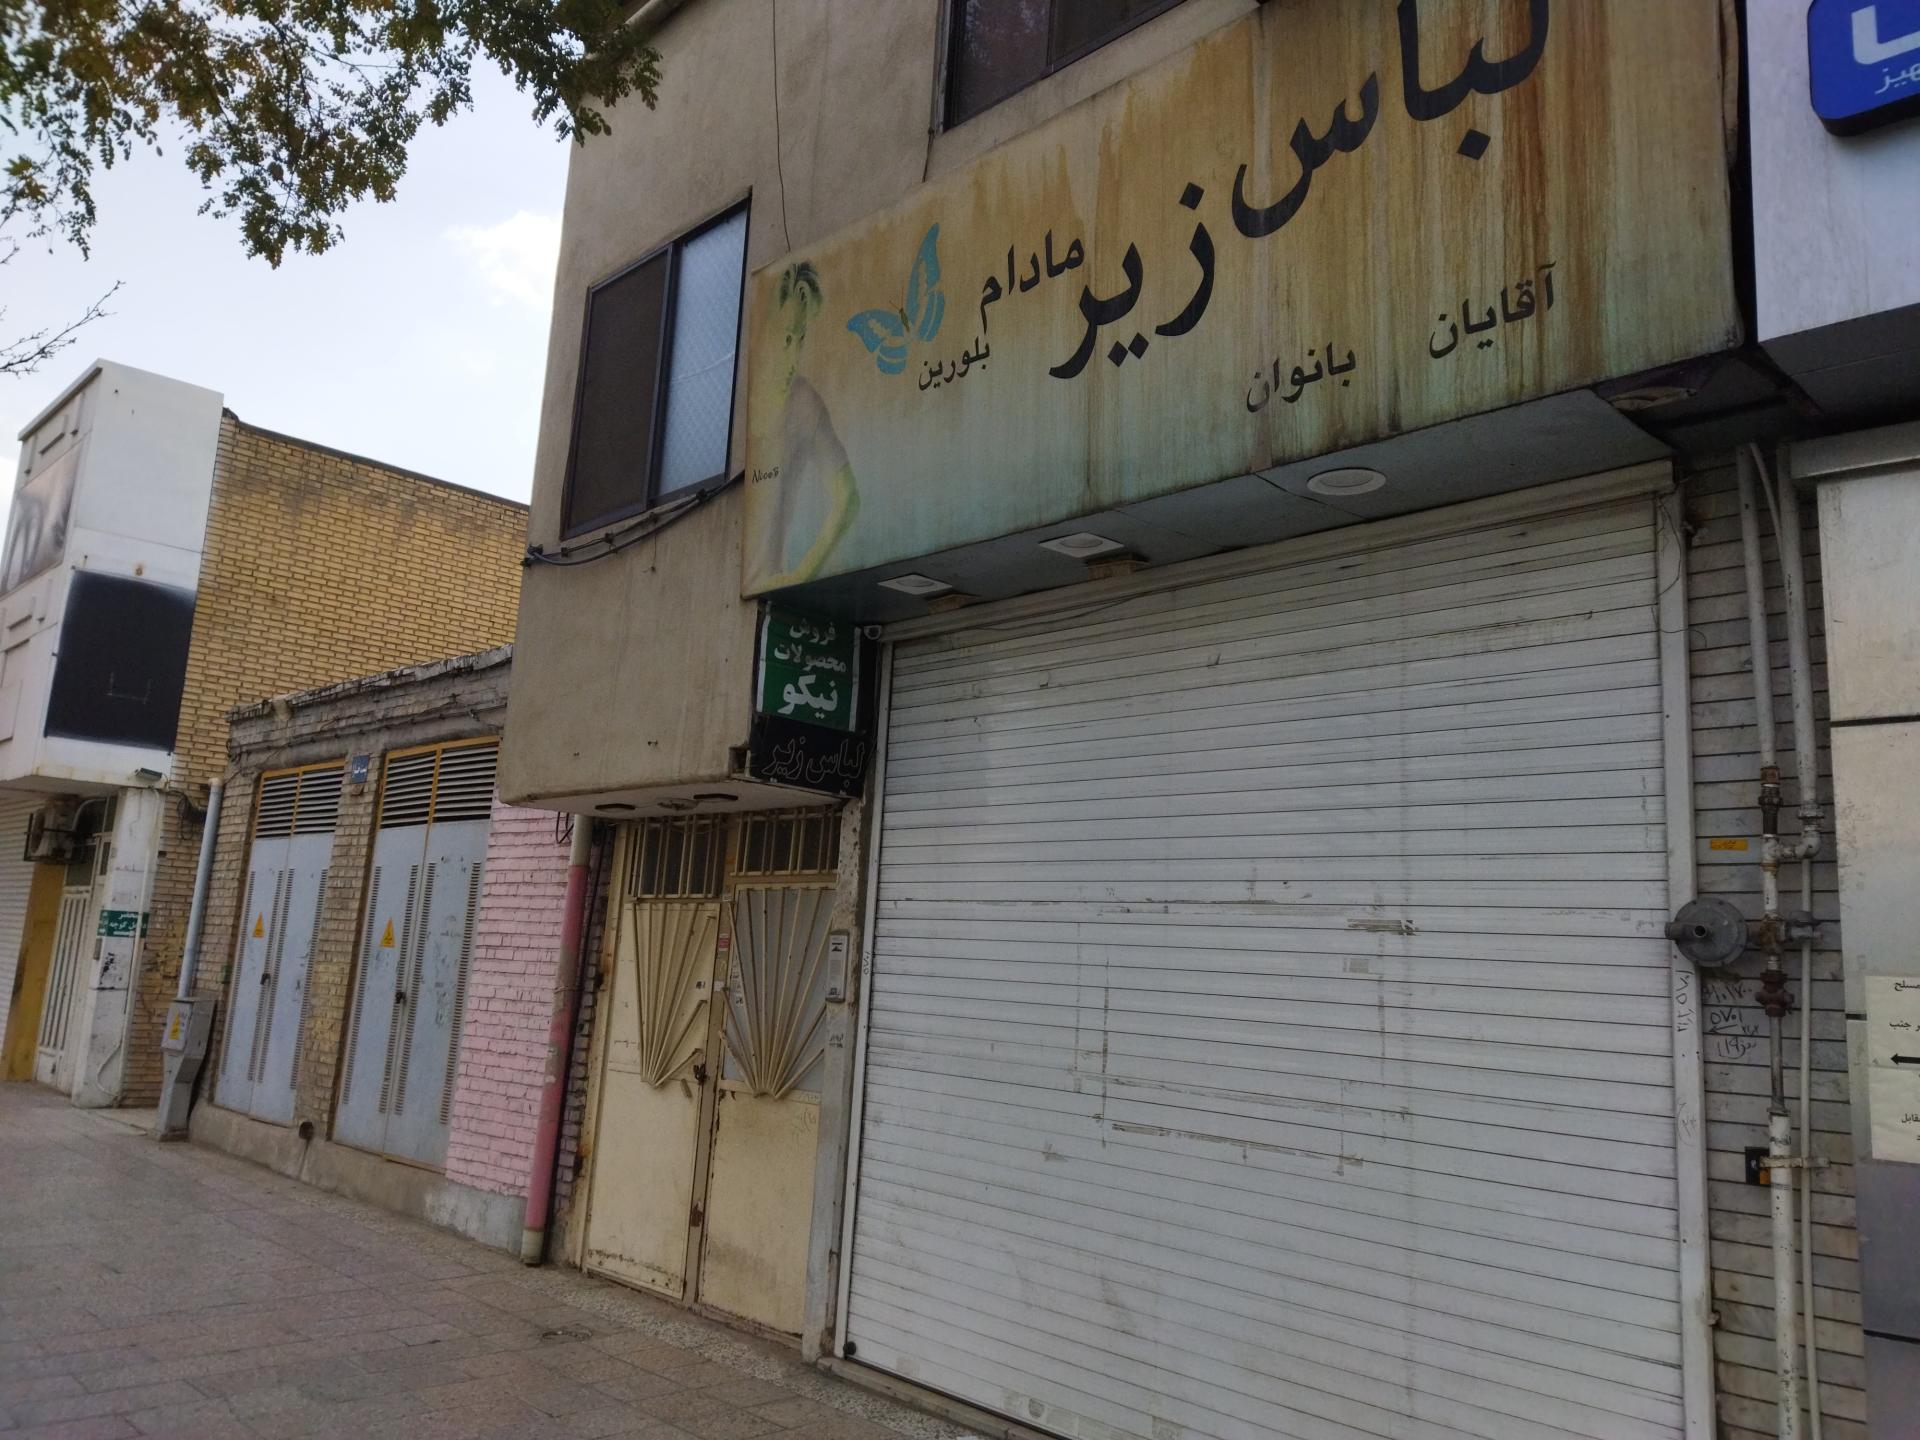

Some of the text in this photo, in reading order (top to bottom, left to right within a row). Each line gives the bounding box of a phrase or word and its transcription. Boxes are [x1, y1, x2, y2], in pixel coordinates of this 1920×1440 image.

[1049, 0, 1550, 380] لباس زیر
[979, 229, 1085, 332] مادام
[1428, 262, 1557, 360] آقایان
[918, 338, 991, 391] بلورین
[1245, 341, 1357, 414] بانوان
[788, 616, 837, 645] فروش
[773, 642, 848, 673] محصولات
[777, 674, 838, 719] نیکو
[761, 735, 865, 788] لباس زیر
